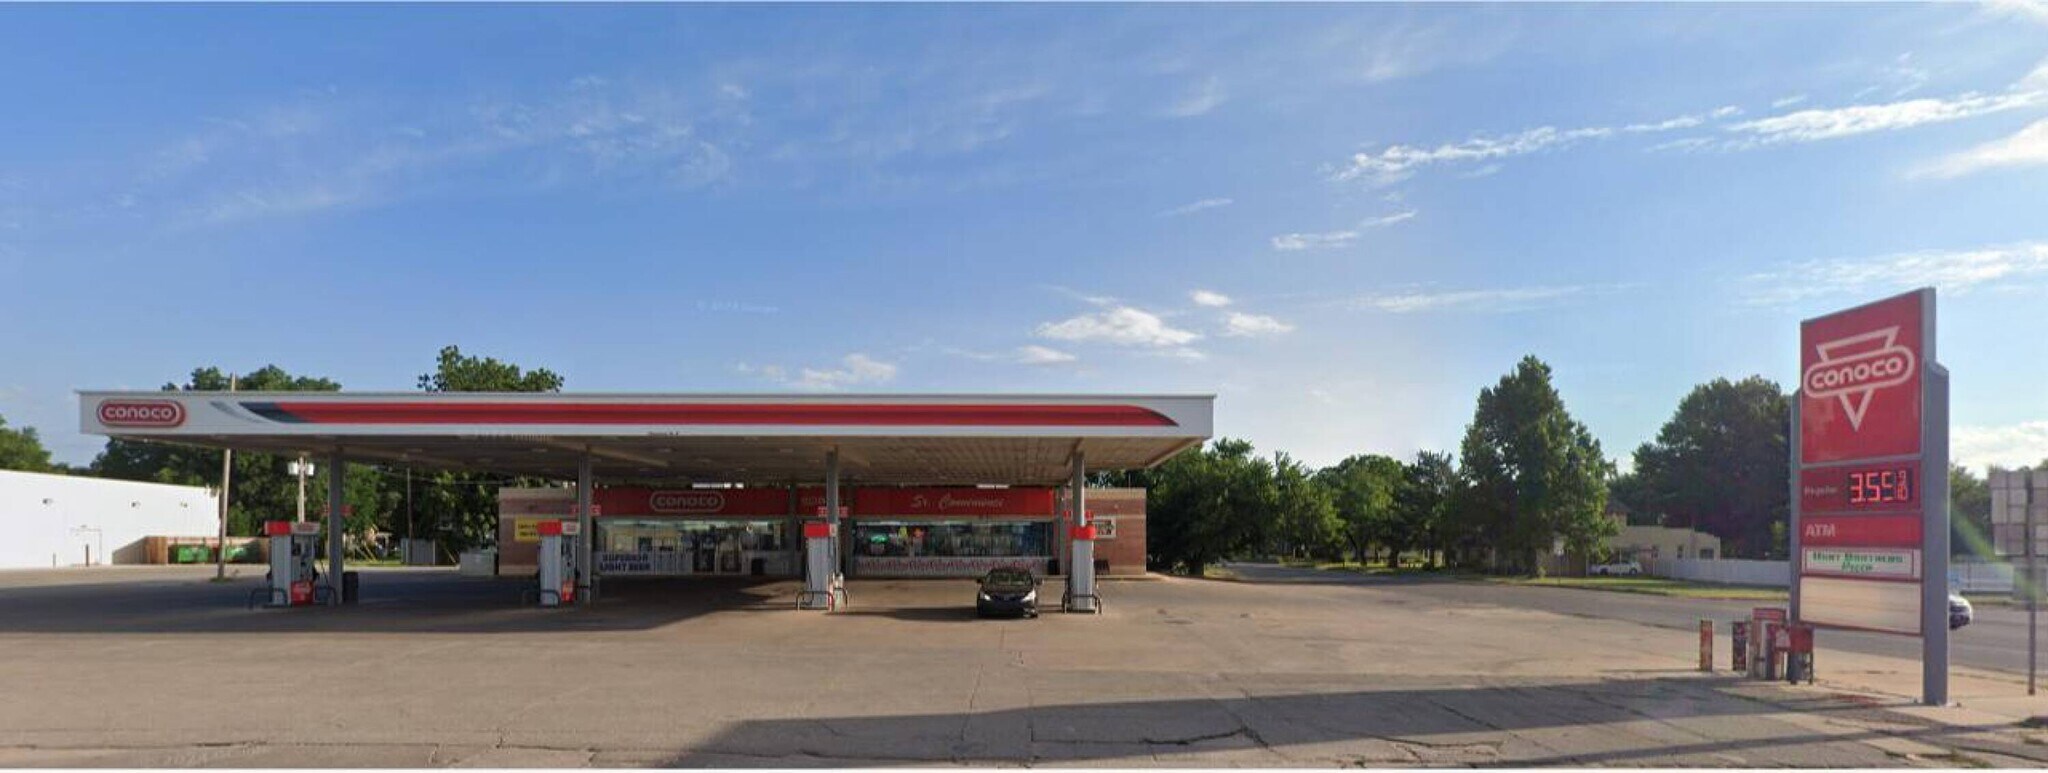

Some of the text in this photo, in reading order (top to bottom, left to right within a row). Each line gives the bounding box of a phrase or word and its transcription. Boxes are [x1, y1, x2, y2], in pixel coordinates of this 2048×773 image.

[1811, 357, 1903, 389] conoco
[105, 406, 172, 419] conoco
[656, 496, 718, 507] conoco
[1805, 523, 1836, 537] ATM
